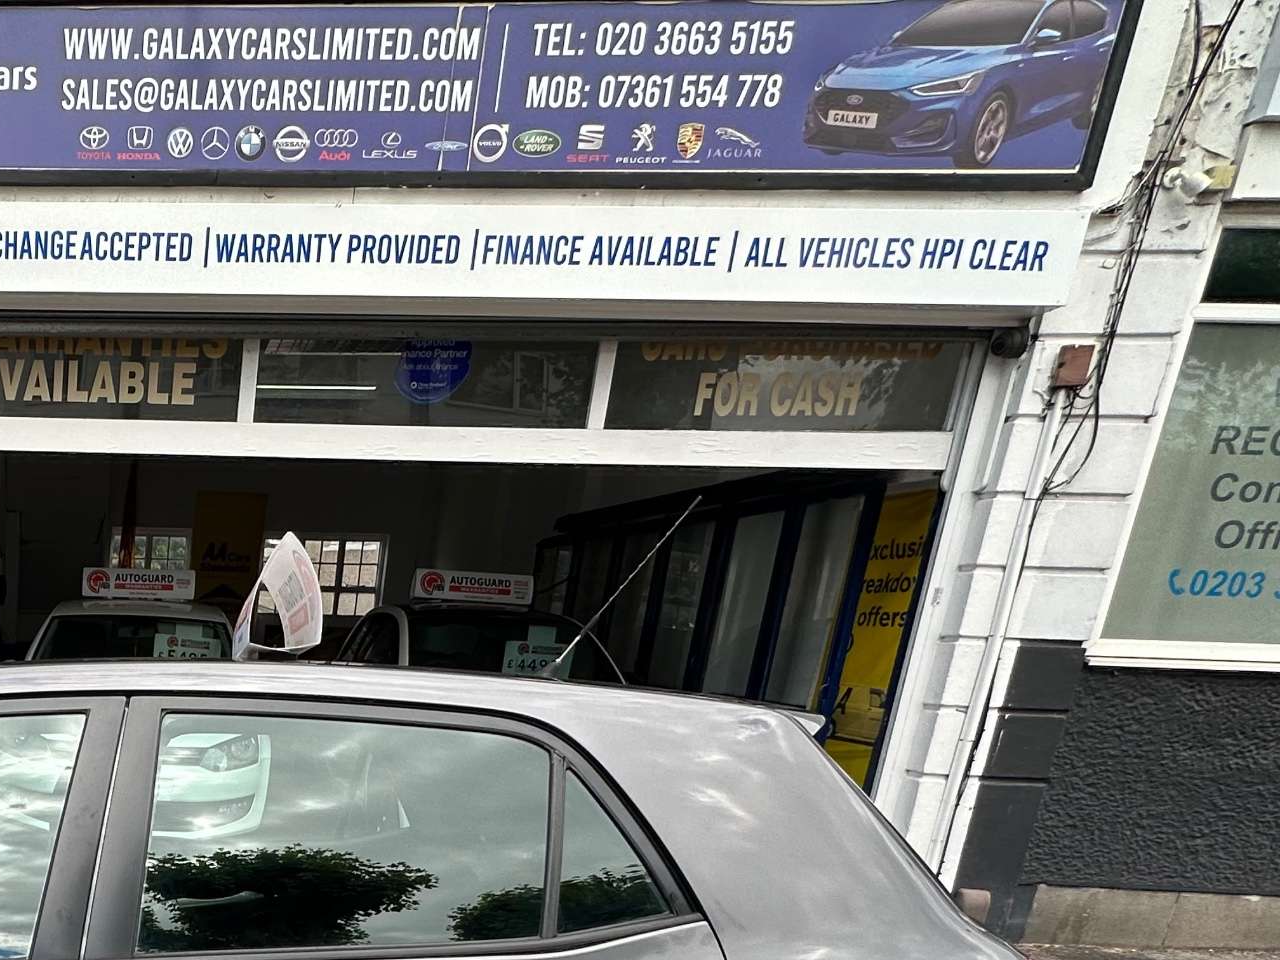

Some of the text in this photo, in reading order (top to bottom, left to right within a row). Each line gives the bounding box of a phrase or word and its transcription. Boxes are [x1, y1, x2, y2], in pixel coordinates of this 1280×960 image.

[63, 27, 481, 61] WWW.GALAXYCARSLIMITED.COM
[532, 21, 795, 56] TEL: 020 3663 5155
[61, 78, 474, 113] SALES@GALAXYCARSLIMITED.COM
[525, 74, 781, 108] MOB: 07361 554 778
[833, 113, 871, 125] GALAXY
[275, 140, 307, 148] NISSAN
[362, 149, 419, 159] LEXUS
[706, 148, 763, 159] JAGUAR
[76, 151, 111, 161] TOYOTA
[117, 152, 161, 160] HONDA
[566, 154, 609, 163] SEAT
[615, 156, 668, 165] PEUGEOT
[79, 232, 193, 262] ACCEPTED
[216, 234, 461, 265] WARRANTY PROVIDED
[482, 235, 721, 267] FINANCE AVAILABLE
[746, 238, 1049, 272] ALL VEHICLES HPI CLEAR
[693, 371, 865, 417] FOR CASH
[870, 536, 924, 561] xclusi
[114, 573, 174, 584] AUTOGUARD
[450, 576, 511, 588] AUTOGUARD
[861, 573, 917, 594] reakdo
[1189, 570, 1266, 599] 0203
[857, 606, 908, 627] offers
